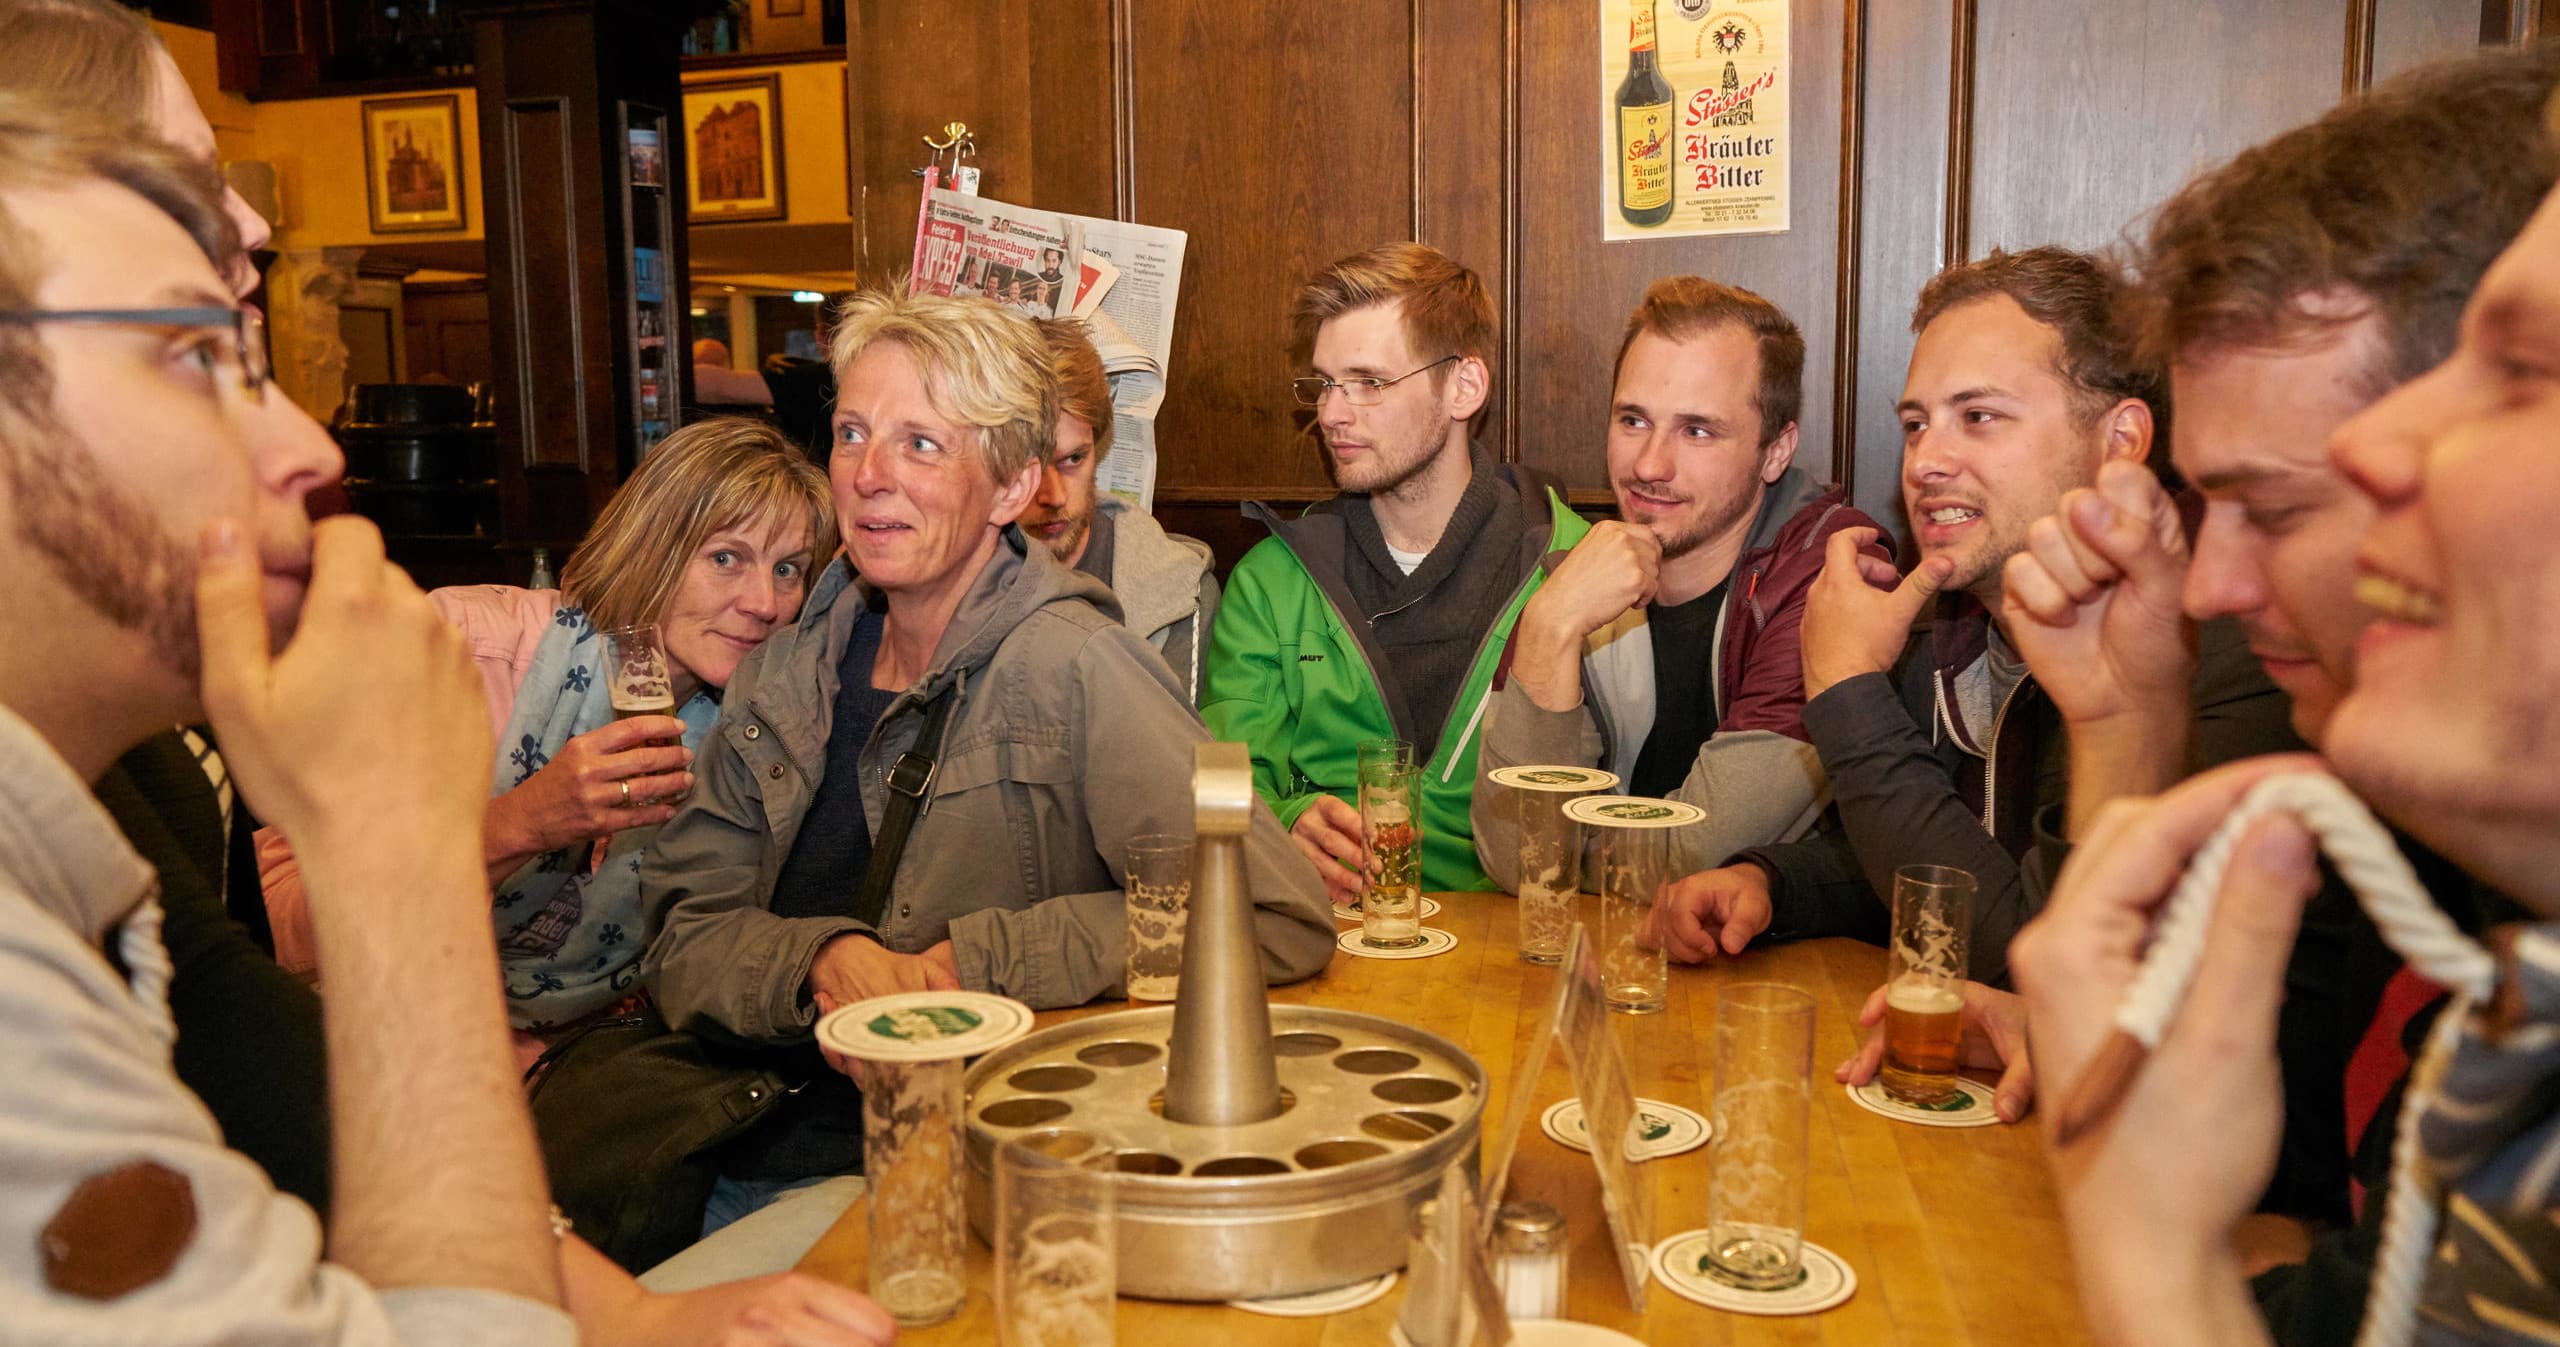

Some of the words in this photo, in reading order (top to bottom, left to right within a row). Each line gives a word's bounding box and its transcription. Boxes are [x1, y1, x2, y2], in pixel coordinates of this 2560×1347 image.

[1685, 134, 1774, 162] Kräuter
[1636, 177, 1665, 190] Bitter
[1695, 164, 1764, 191] Bitter
[967, 230, 1036, 260] Veröffentlichung
[998, 253, 1024, 268] Tawil
